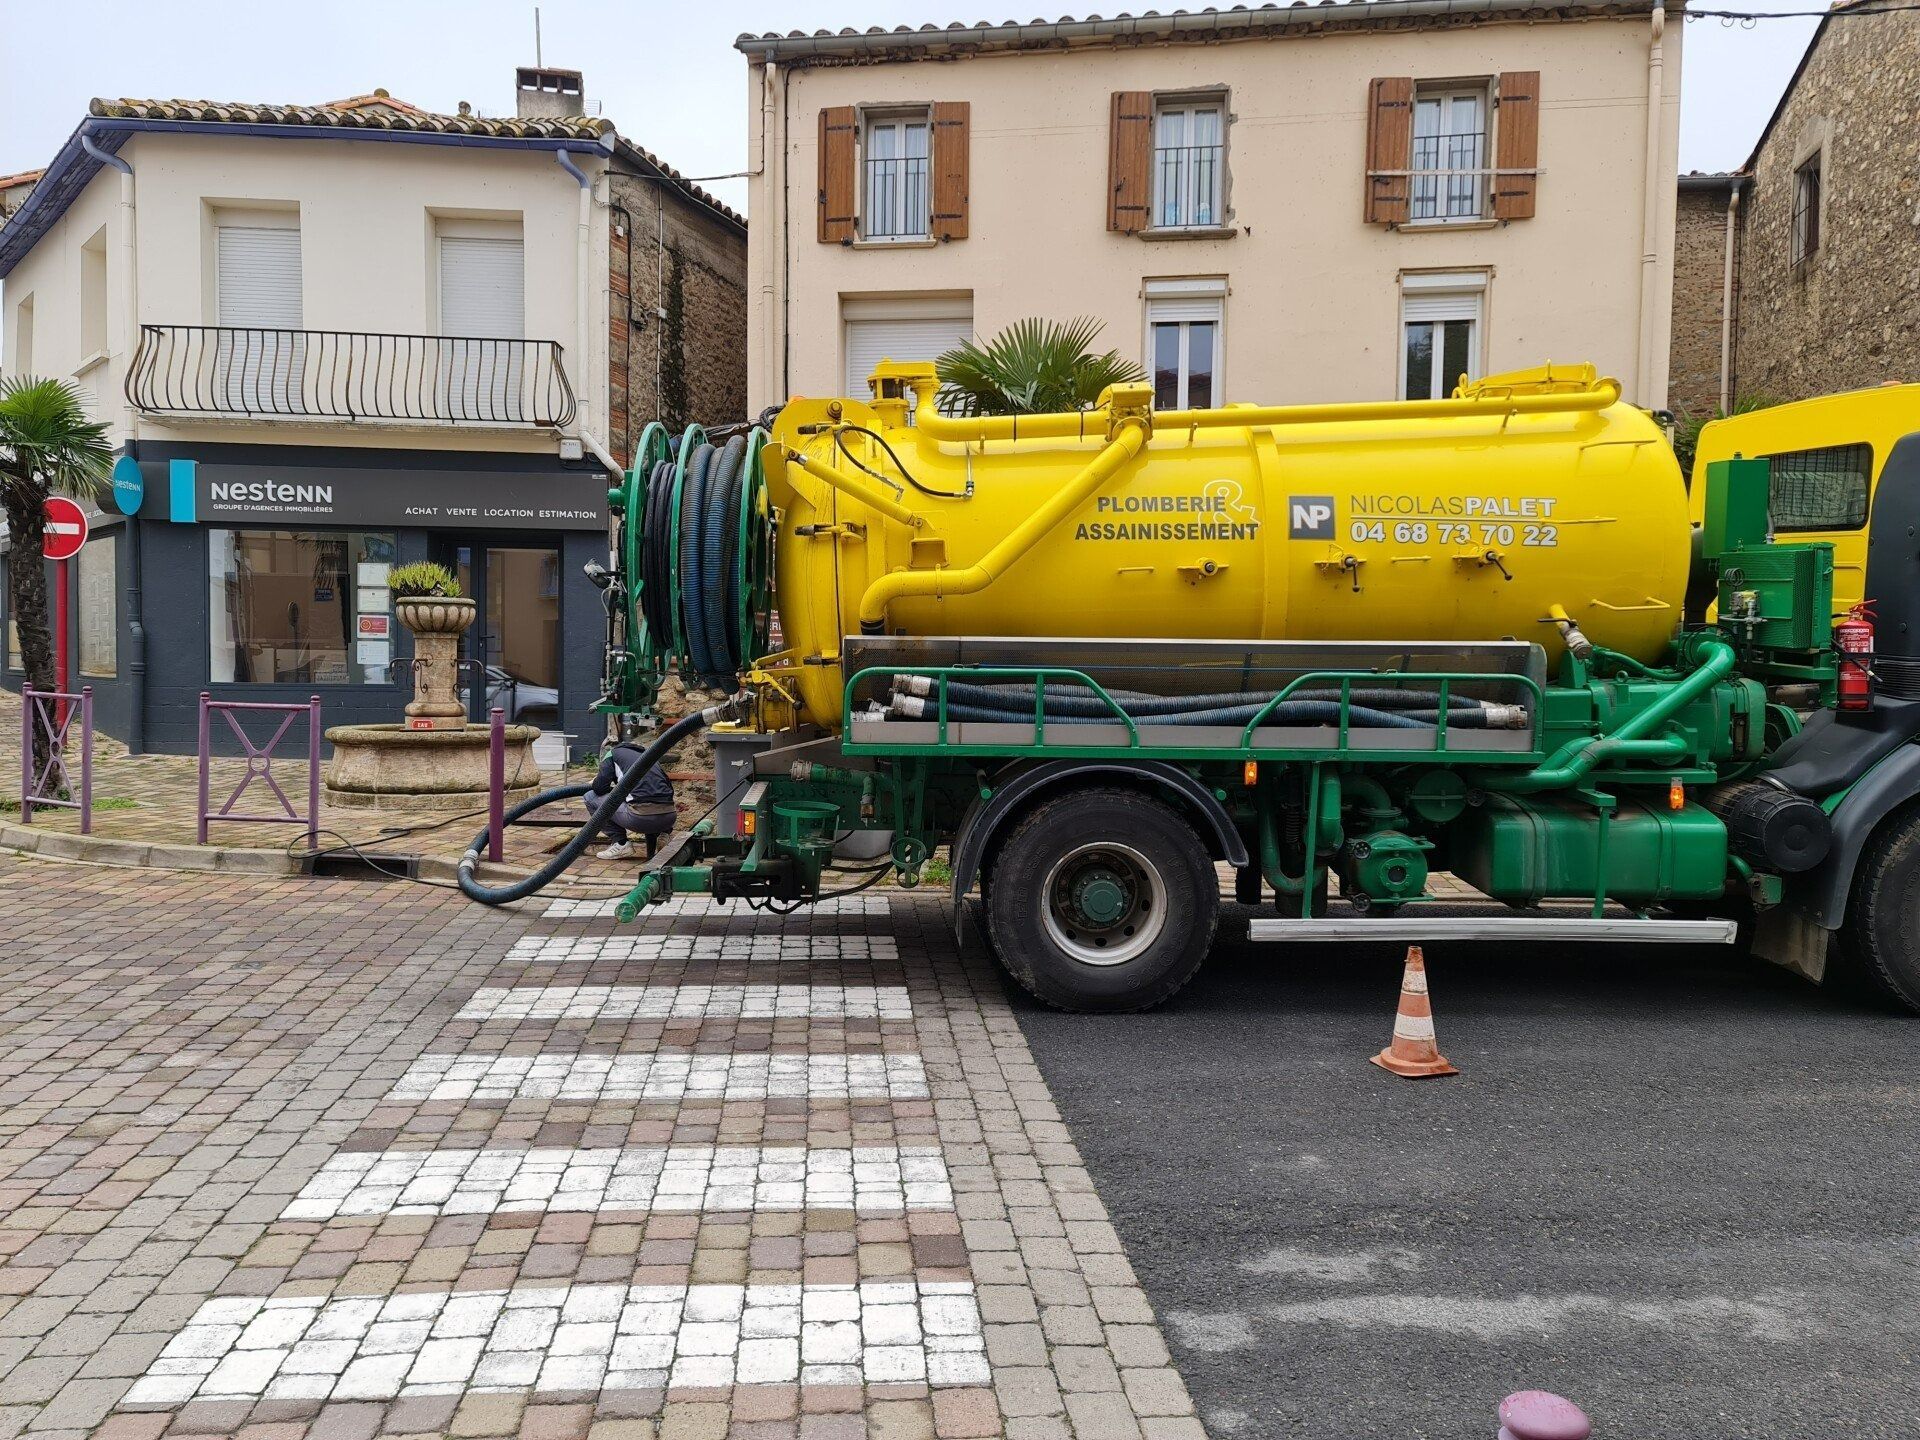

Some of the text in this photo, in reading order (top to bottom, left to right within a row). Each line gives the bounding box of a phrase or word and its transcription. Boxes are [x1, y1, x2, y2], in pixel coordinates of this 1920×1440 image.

[212, 503, 334, 513] GROUPE D'AGENCES IMMOBILIÈRES
[404, 507, 597, 519] ACHAT VENTE LOCATION ESTIMATION
[1097, 496, 1227, 513] PLOMBERIE
[1292, 504, 1331, 530] NP
[1074, 522, 1259, 541] ASSAINISSEMENT
[1350, 521, 1559, 547] 04 68 73 70 22
